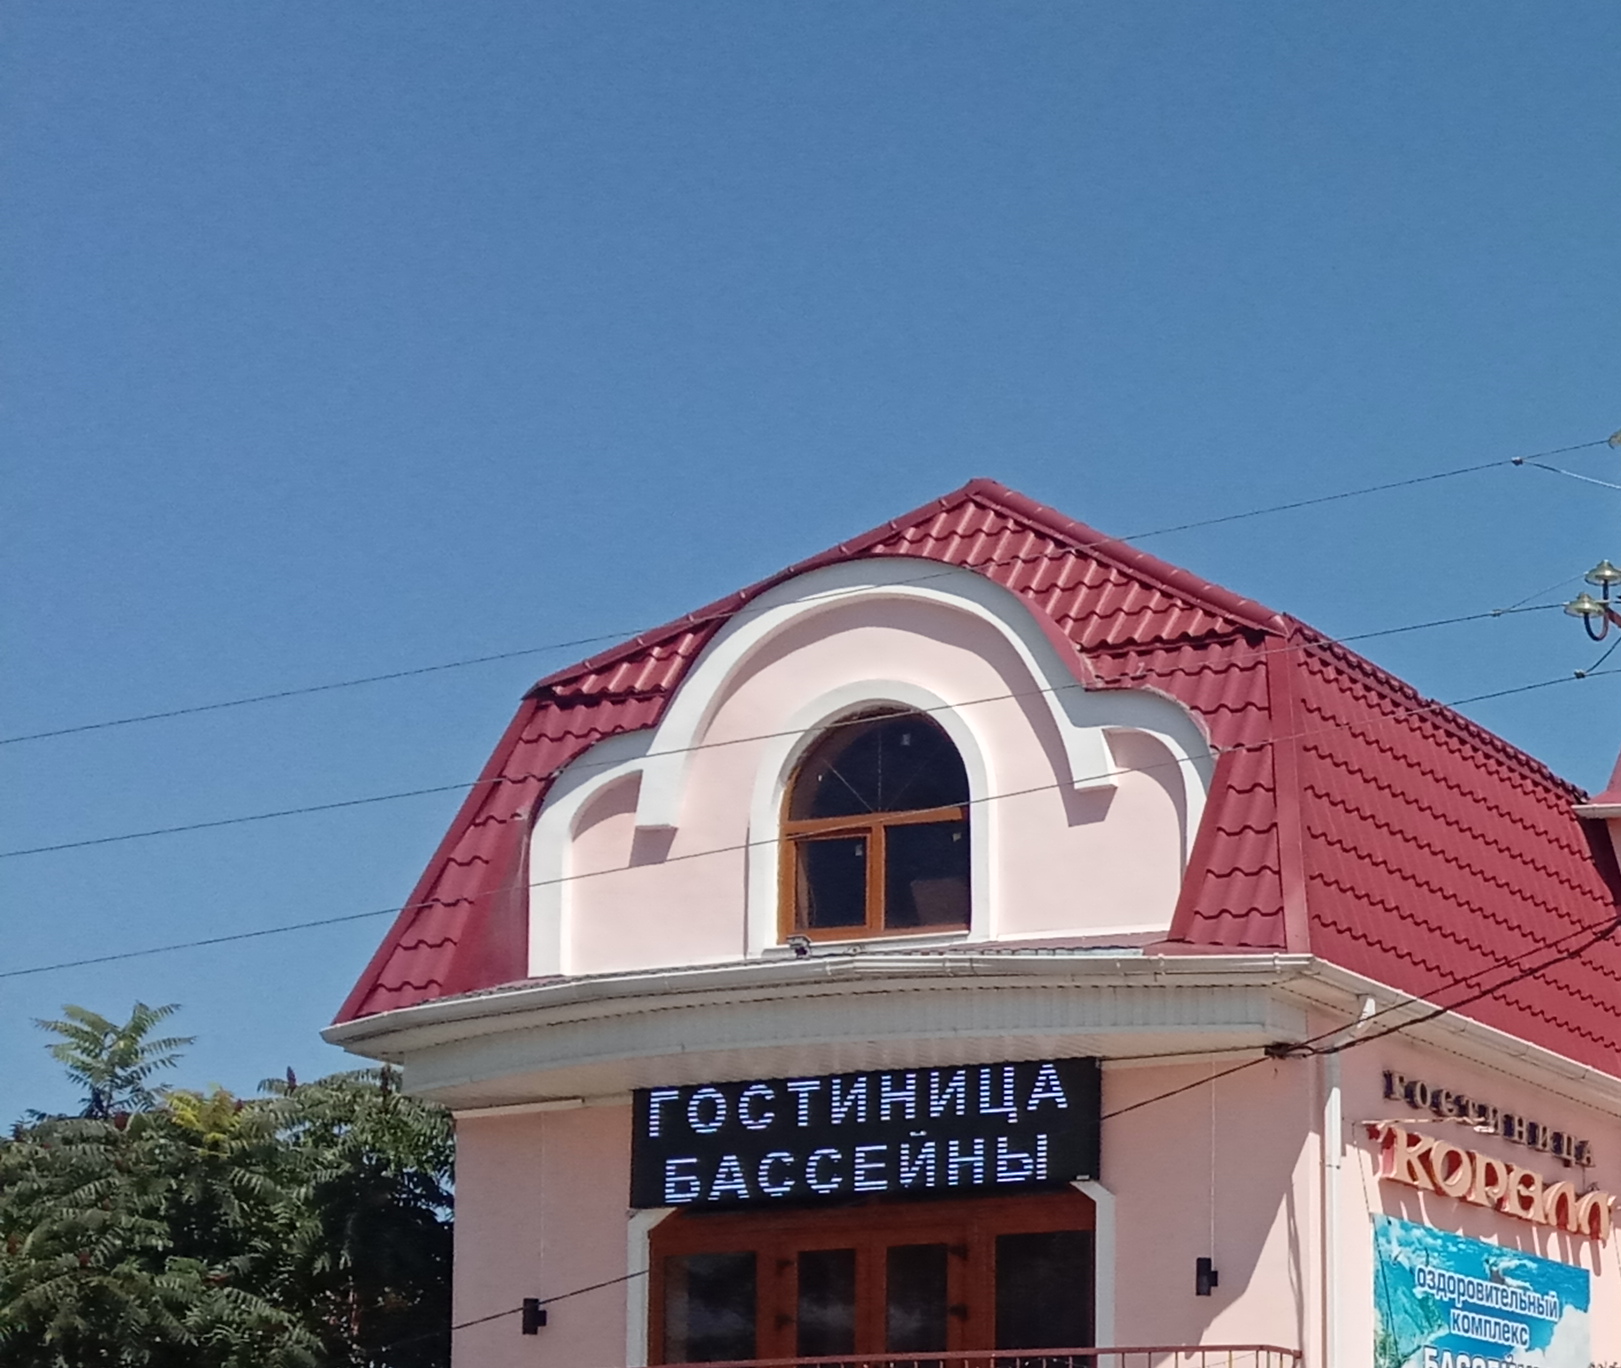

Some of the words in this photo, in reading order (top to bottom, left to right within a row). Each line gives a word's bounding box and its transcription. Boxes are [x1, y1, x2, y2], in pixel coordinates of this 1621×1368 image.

[649, 1063, 1069, 1137] ГОСТИНИЦА
[665, 1130, 1048, 1204] БАССЕЙНЫ
[1417, 1267, 1559, 1321] оздоровительный
[1452, 1310, 1529, 1346] комплекс
